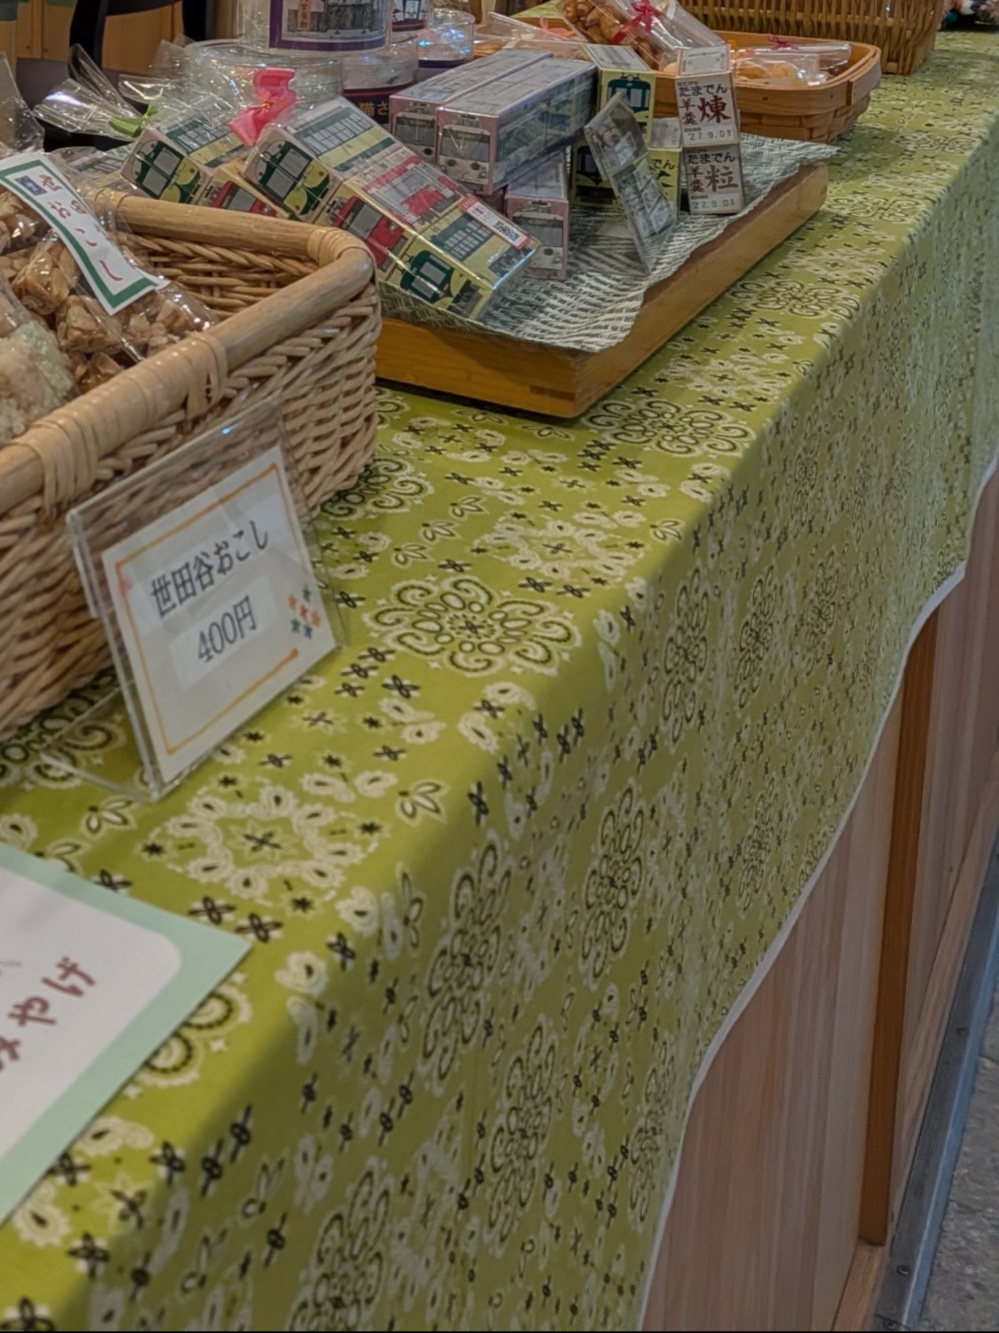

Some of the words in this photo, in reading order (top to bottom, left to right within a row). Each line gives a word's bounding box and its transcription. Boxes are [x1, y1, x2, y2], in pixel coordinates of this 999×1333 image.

[679, 83, 728, 98] たまでん
[687, 152, 736, 165] たまでん
[705, 164, 739, 192] 粒
[48, 200, 124, 282] おこし
[150, 520, 269, 618] 世田谷おこし
[197, 594, 257, 663] 400円
